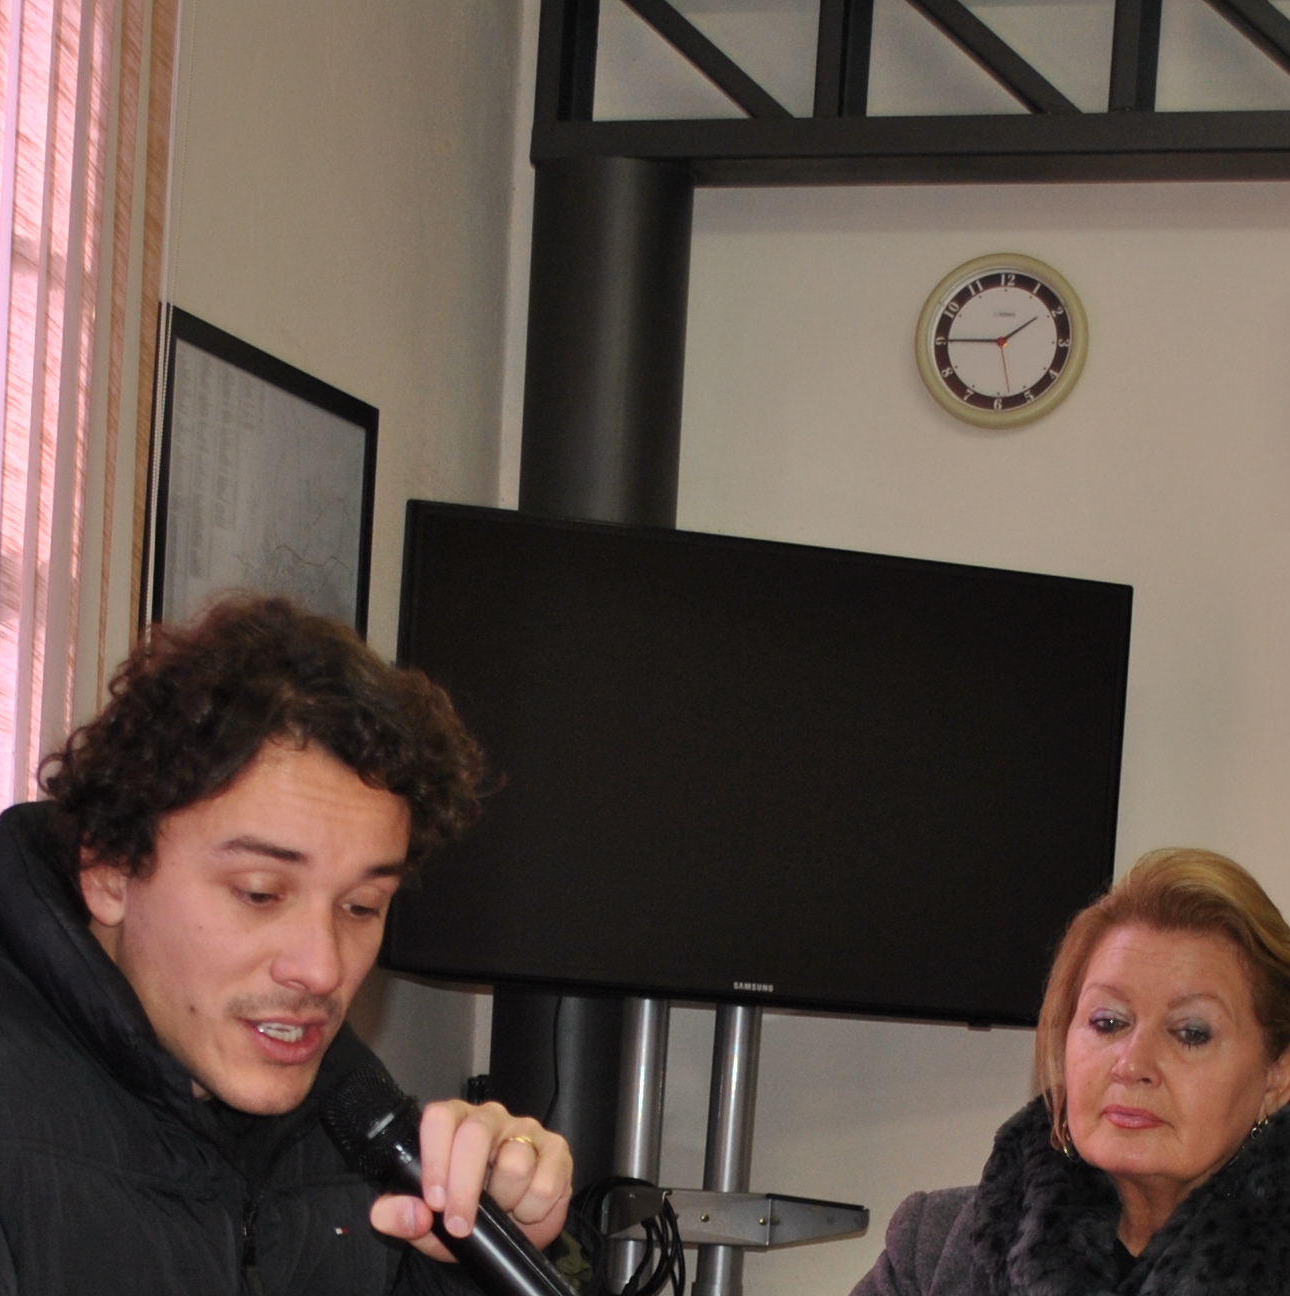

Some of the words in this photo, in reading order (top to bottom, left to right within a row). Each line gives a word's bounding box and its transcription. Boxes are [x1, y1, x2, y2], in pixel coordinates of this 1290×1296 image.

[1001, 274, 1016, 286] 12
[968, 280, 984, 296] 11
[1032, 283, 1041, 294] 1
[943, 302, 959, 319] 10
[1051, 307, 1063, 318] 2
[935, 337, 947, 346] 9
[1058, 338, 1069, 348] 3
[941, 367, 953, 378] 8
[1049, 369, 1059, 380] 4
[963, 390, 974, 401] 7
[1024, 391, 1034, 403] 5
[994, 398, 1002, 410] 6
[733, 981, 774, 992] SAMSUNG
